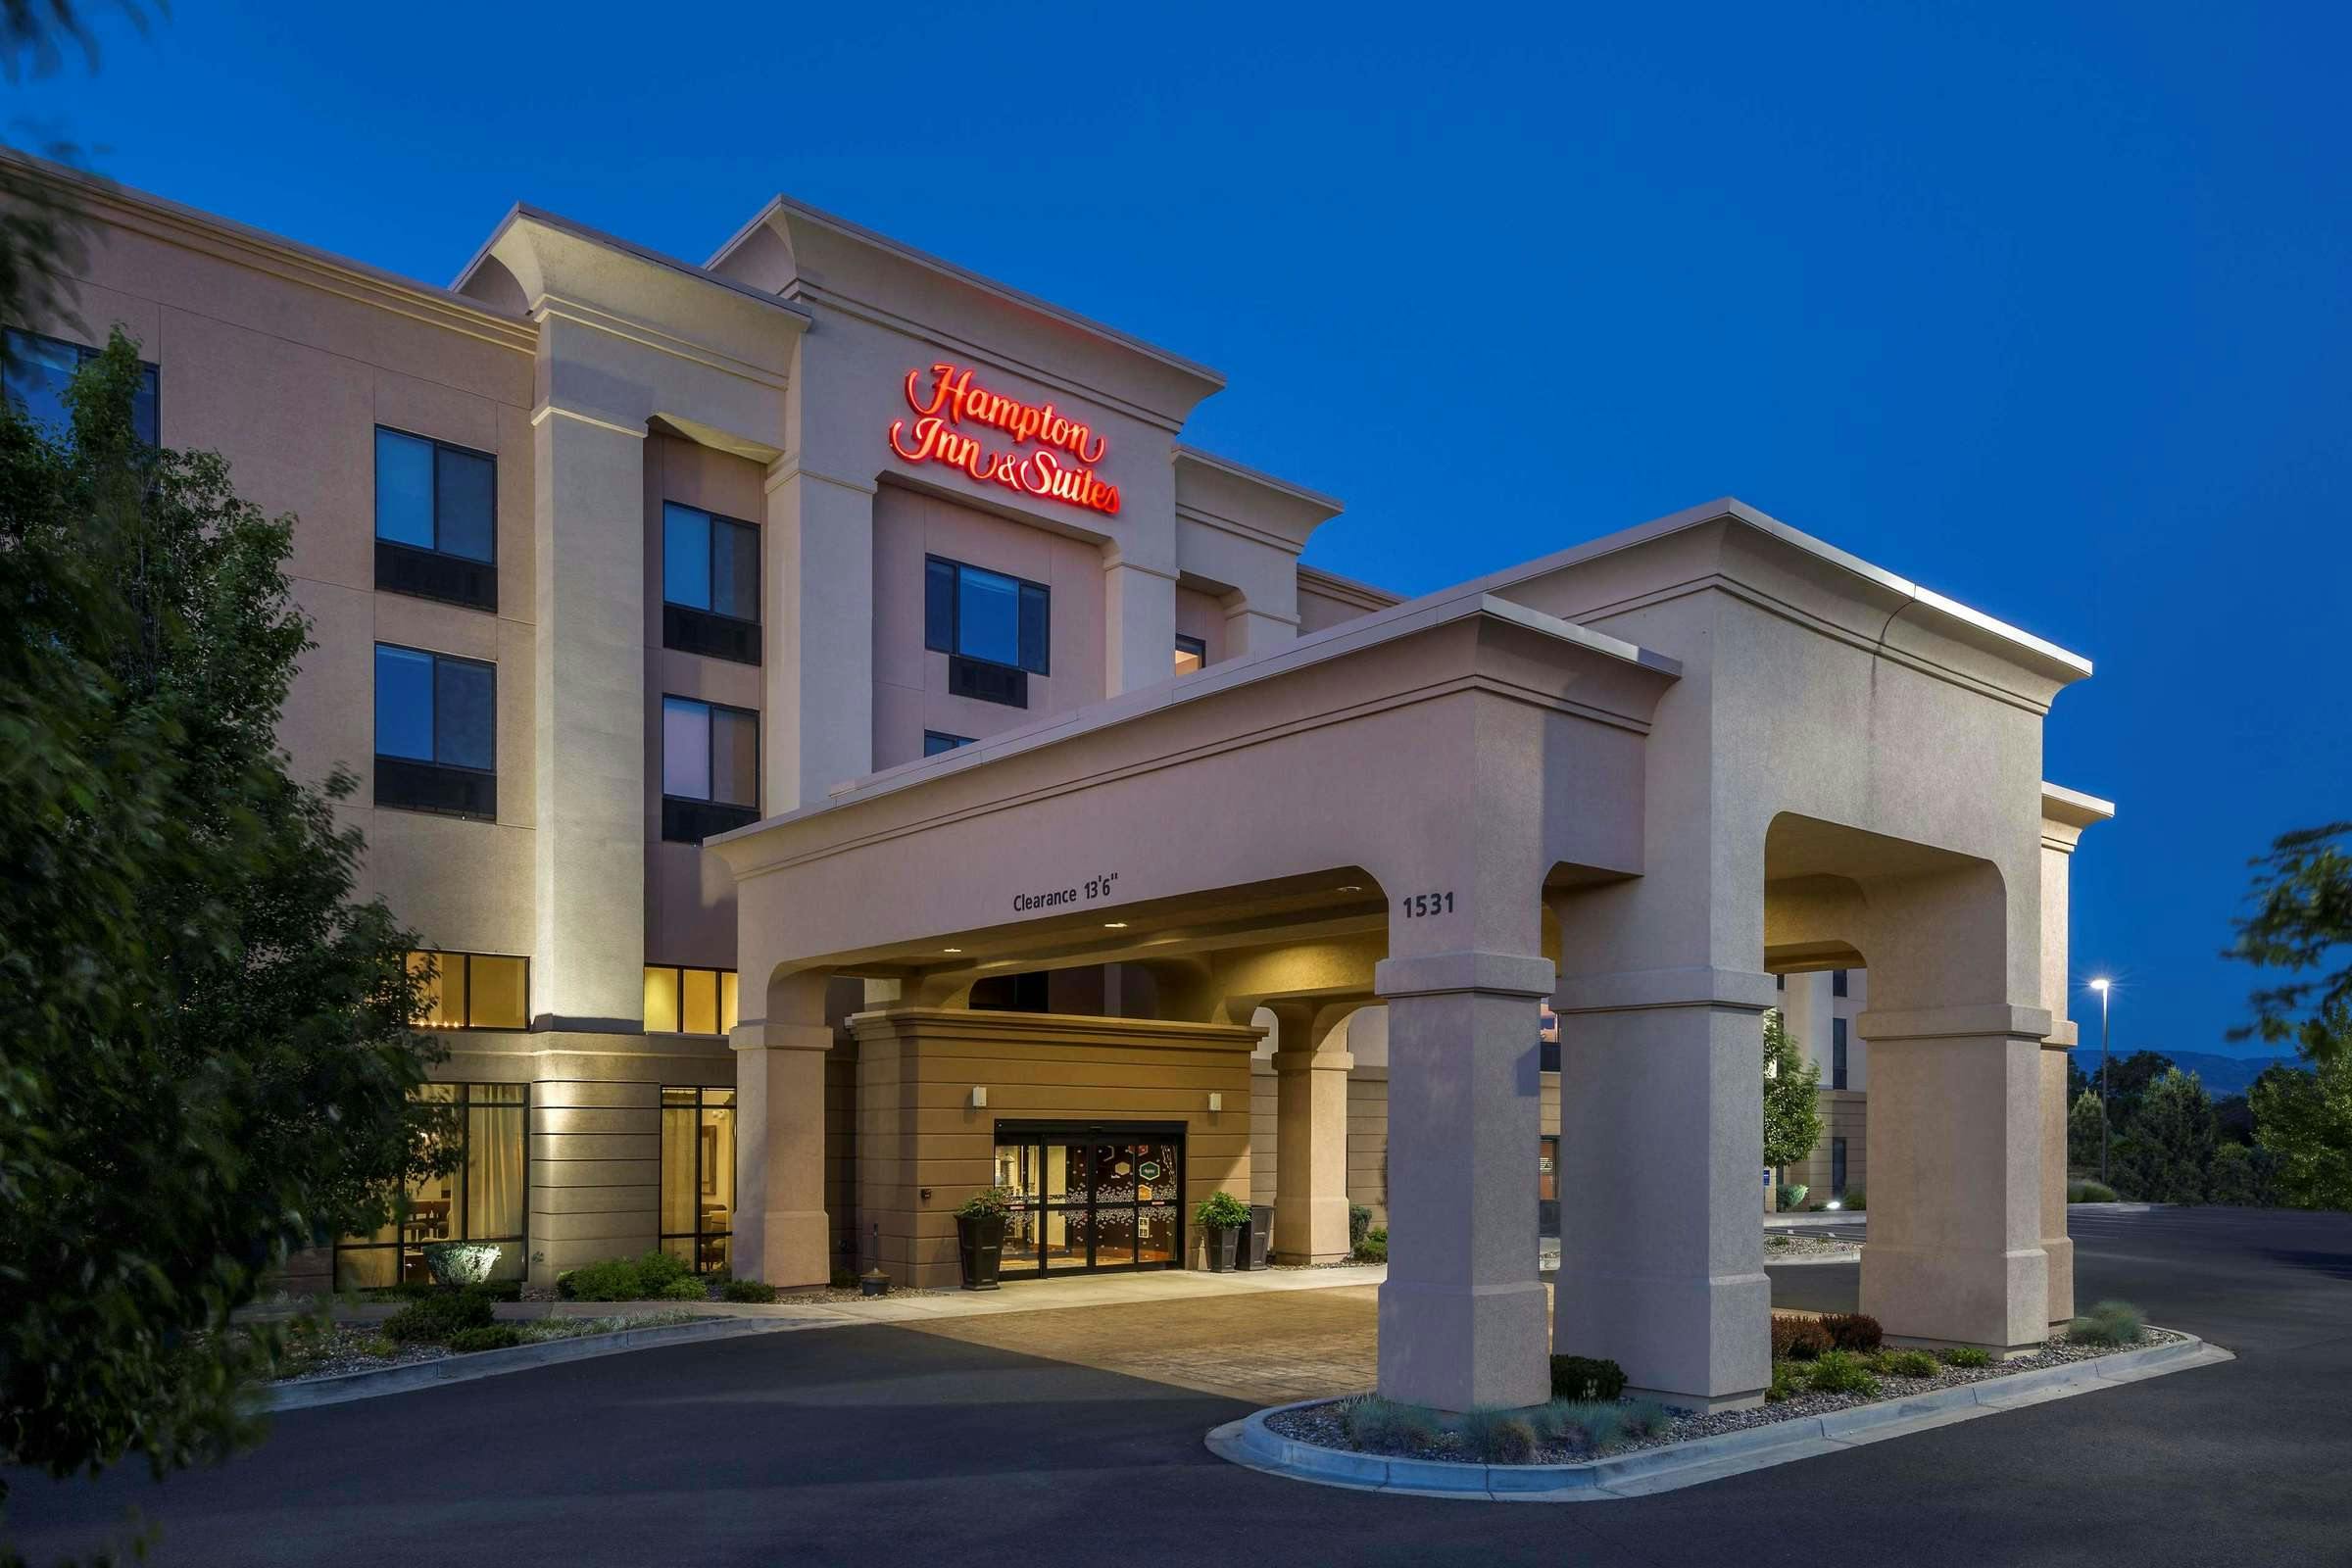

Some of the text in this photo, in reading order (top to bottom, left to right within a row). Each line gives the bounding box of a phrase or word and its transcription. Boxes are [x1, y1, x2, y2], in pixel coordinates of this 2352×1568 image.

[904, 363, 1106, 465] Hampton
[889, 416, 1121, 515] Inn & Suites
[1012, 872, 1119, 912] Clearance 13'6"
[1402, 891, 1455, 919] 1531
